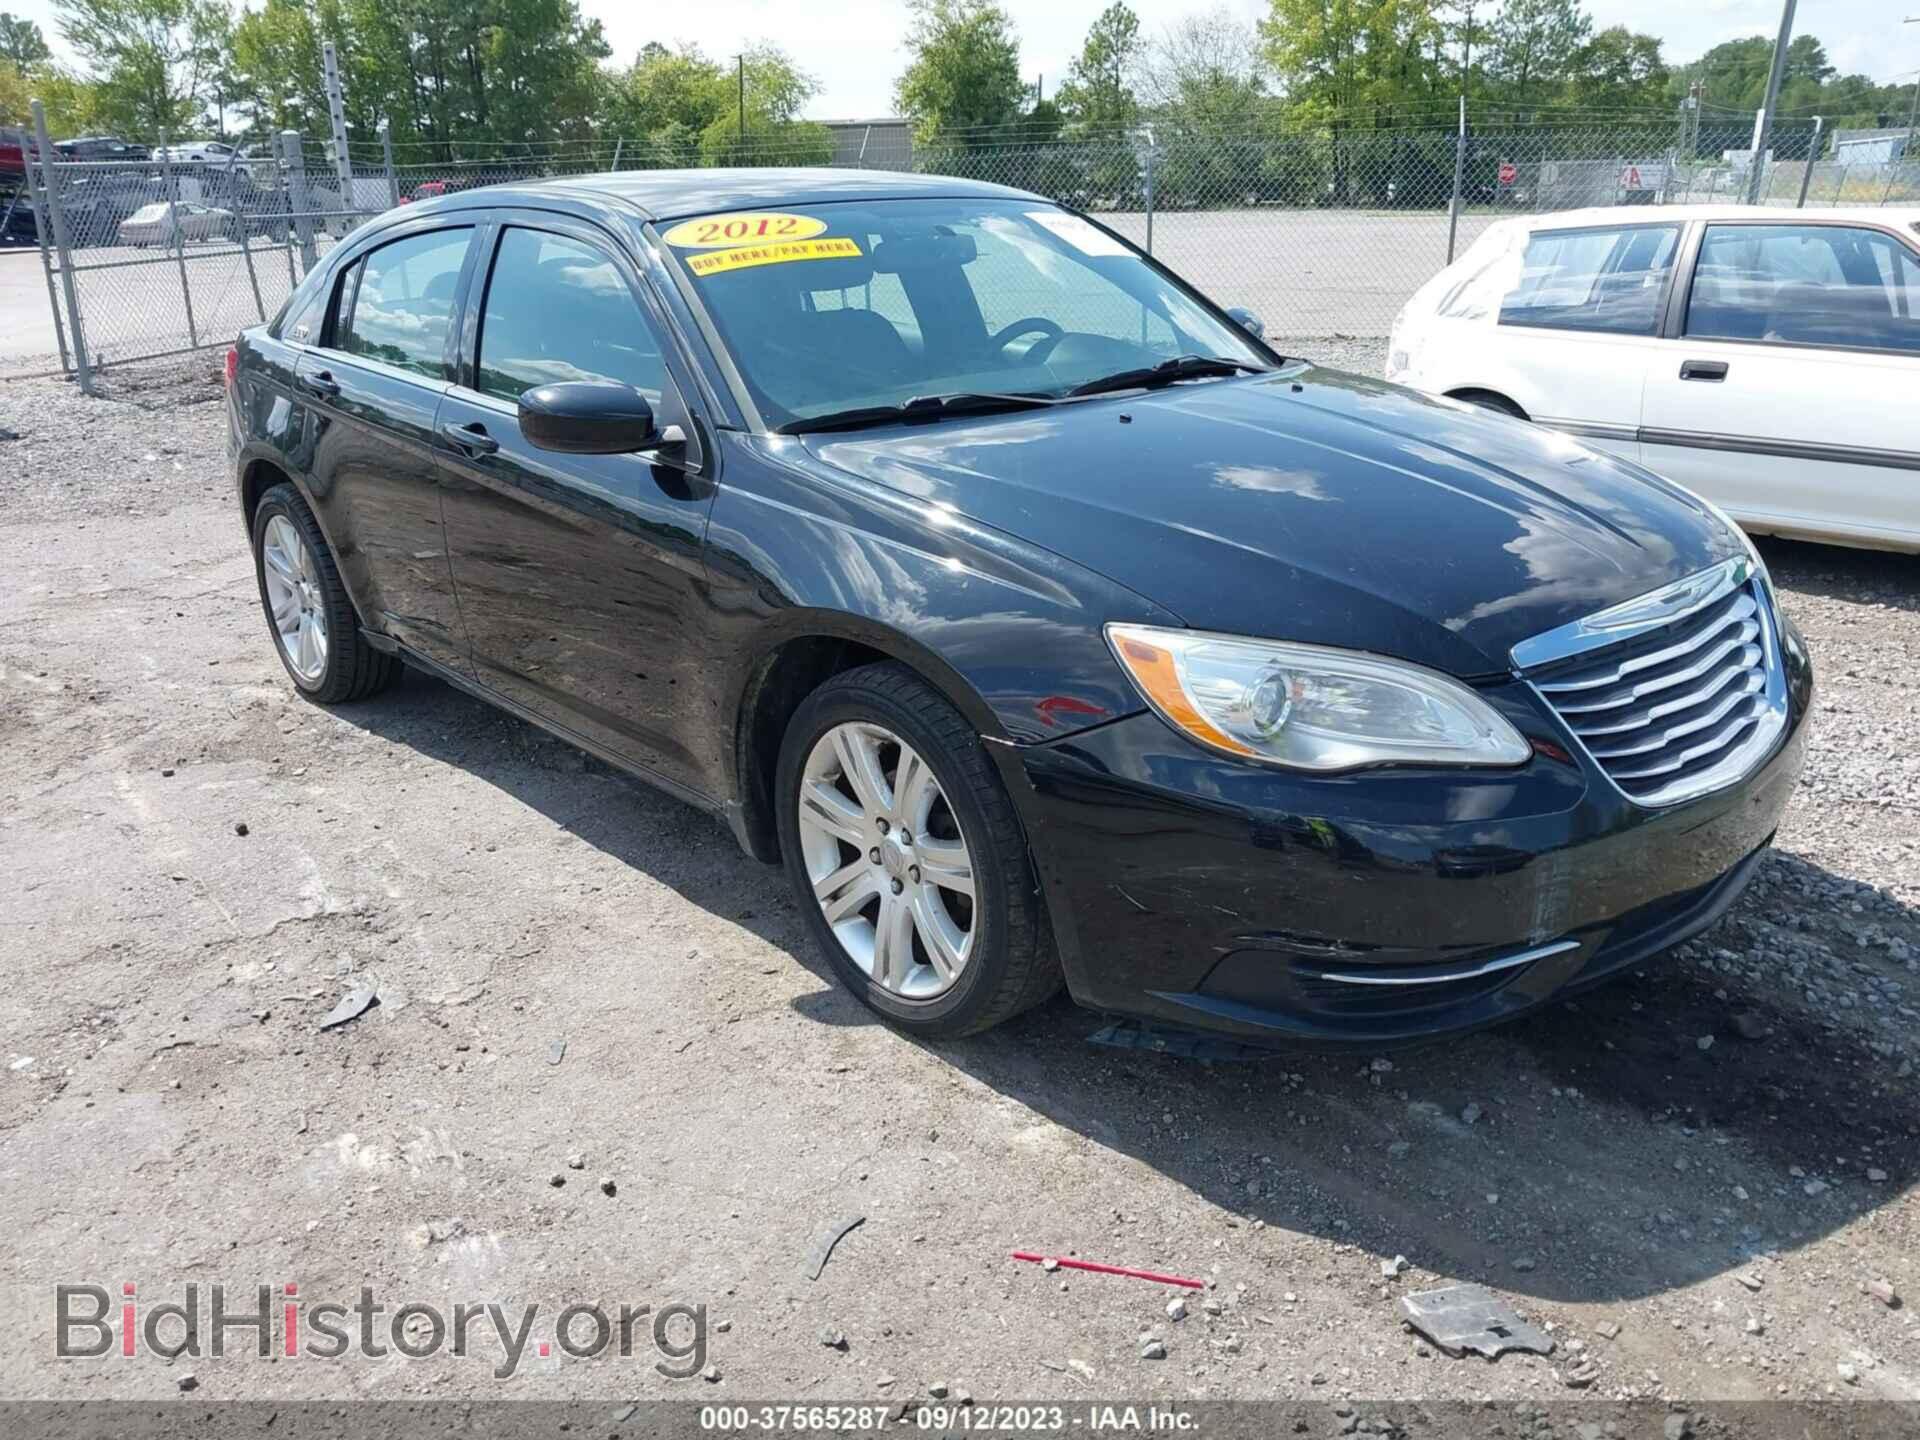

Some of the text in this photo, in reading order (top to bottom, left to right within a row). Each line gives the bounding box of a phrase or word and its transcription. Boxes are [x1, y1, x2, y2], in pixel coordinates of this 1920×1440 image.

[697, 217, 798, 243] 2012
[692, 242, 855, 270] BUY HERE/PAY HERE
